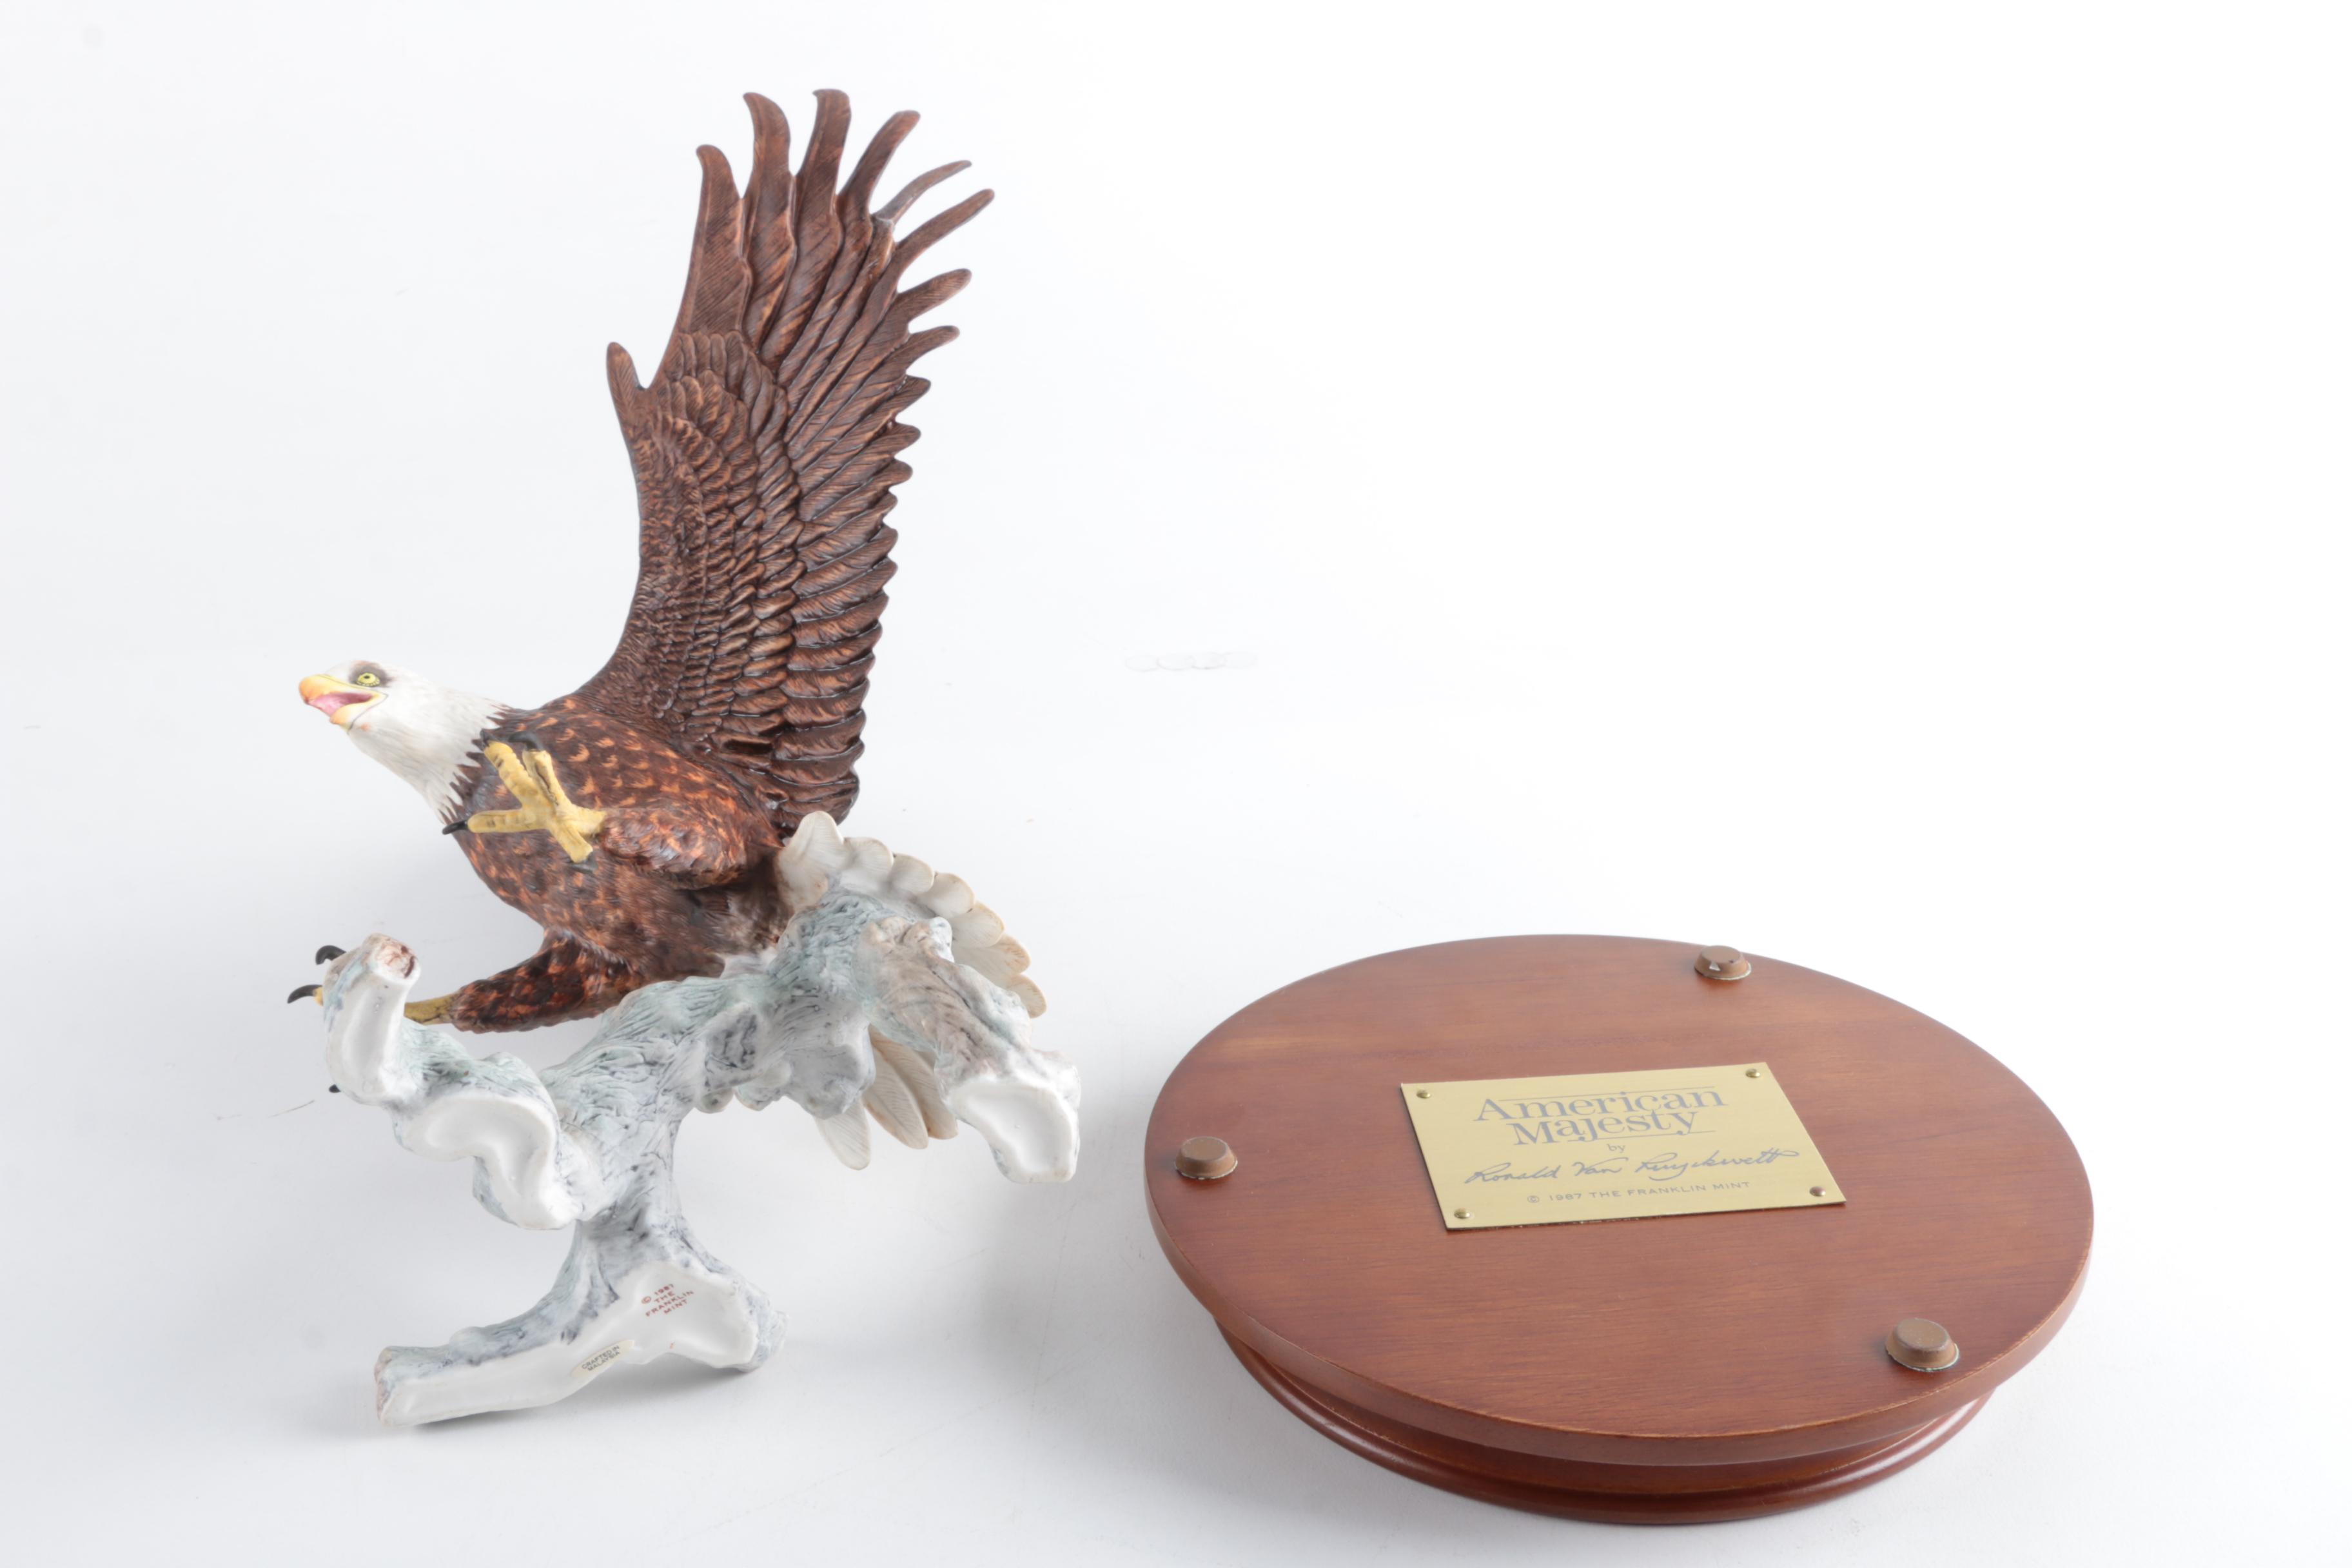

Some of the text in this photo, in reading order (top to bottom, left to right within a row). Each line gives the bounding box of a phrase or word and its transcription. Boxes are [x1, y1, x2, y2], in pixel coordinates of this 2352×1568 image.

[1473, 1090, 1729, 1121] American
[1506, 1109, 1699, 1145] Majesty
[1606, 1143, 1625, 1153] by
[1464, 1162, 1561, 1184] Ronald
[1572, 1157, 1629, 1176] Van
[1627, 1185, 1706, 1196] FRANKLIN
[1712, 1181, 1750, 1190] MINT
[645, 1290, 694, 1317] FRANKLIN
[654, 1291, 675, 1302] THE
[663, 1298, 687, 1314] MINT
[582, 1349, 612, 1369] CRAFTED
[587, 1351, 620, 1371] MALAYSIA
